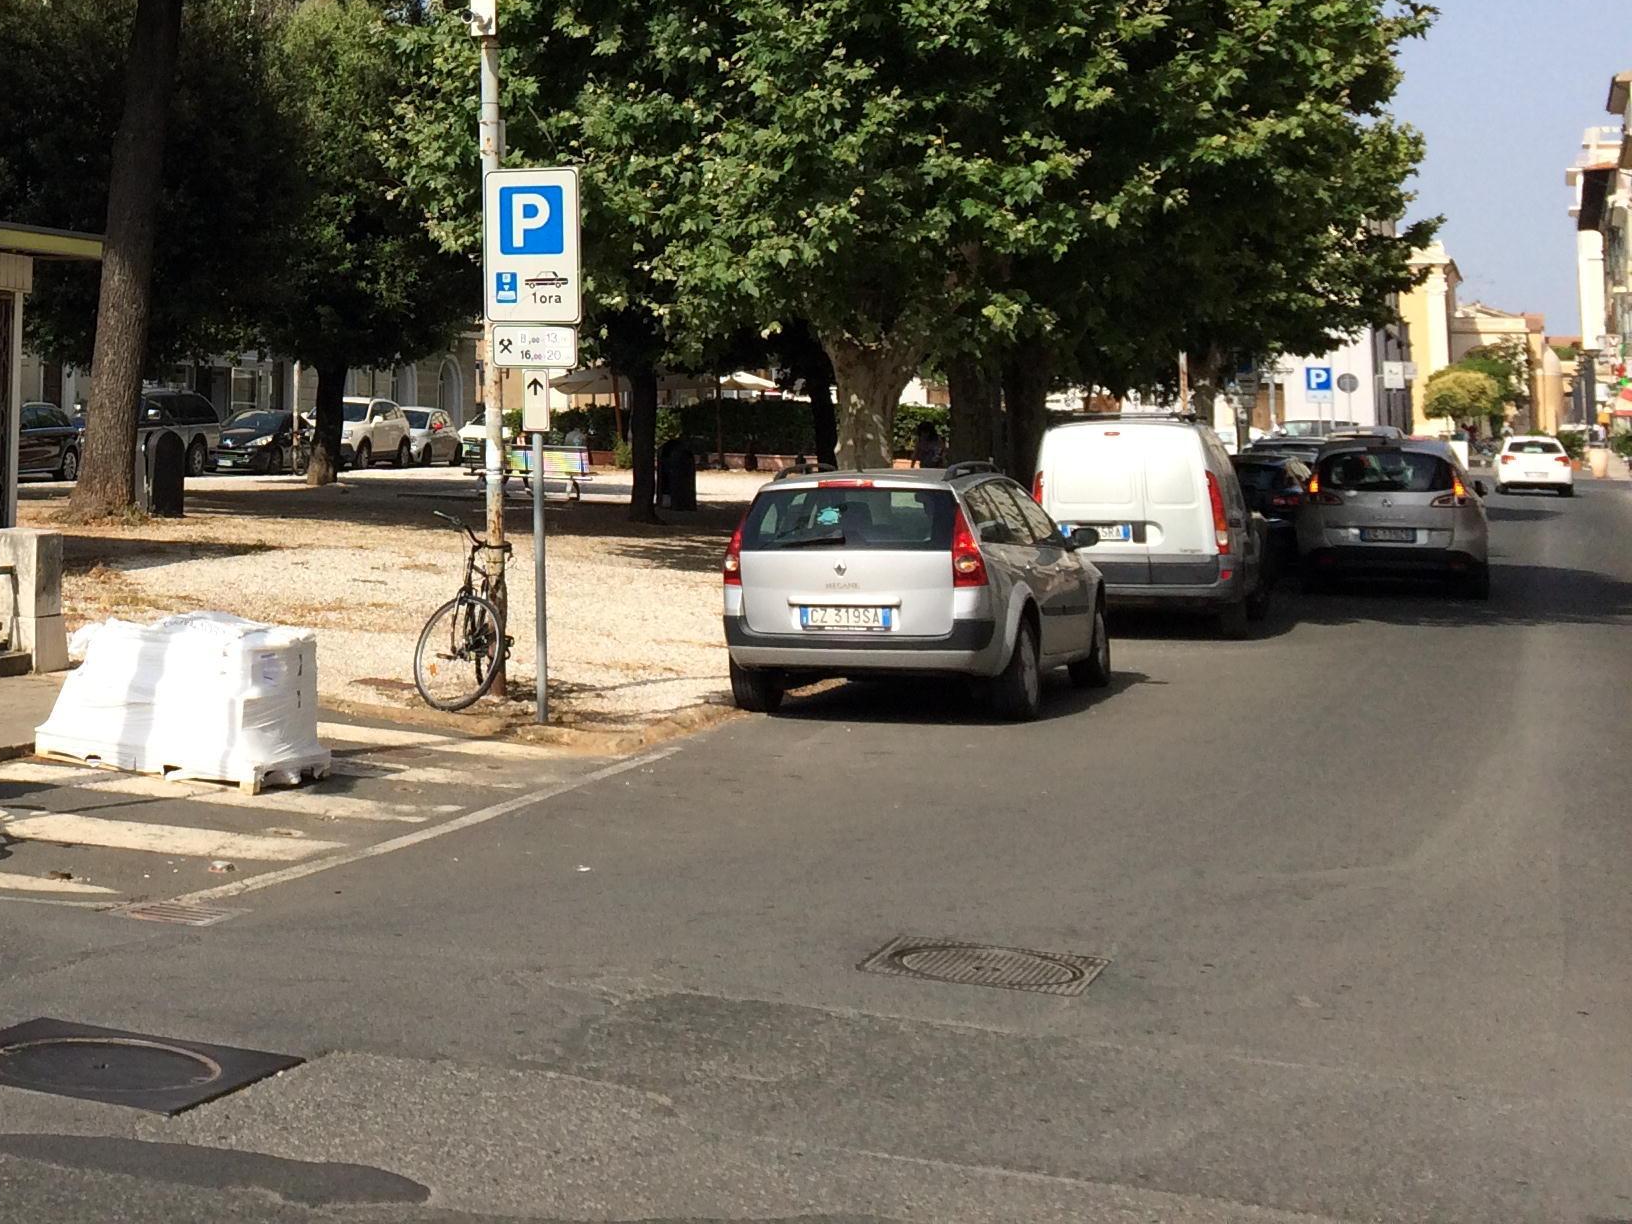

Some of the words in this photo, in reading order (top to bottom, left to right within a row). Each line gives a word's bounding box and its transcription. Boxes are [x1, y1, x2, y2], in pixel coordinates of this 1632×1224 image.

[511, 193, 551, 248] P
[1309, 369, 1328, 389] P
[811, 608, 828, 624] CZ
[834, 608, 880, 624] 319SA
